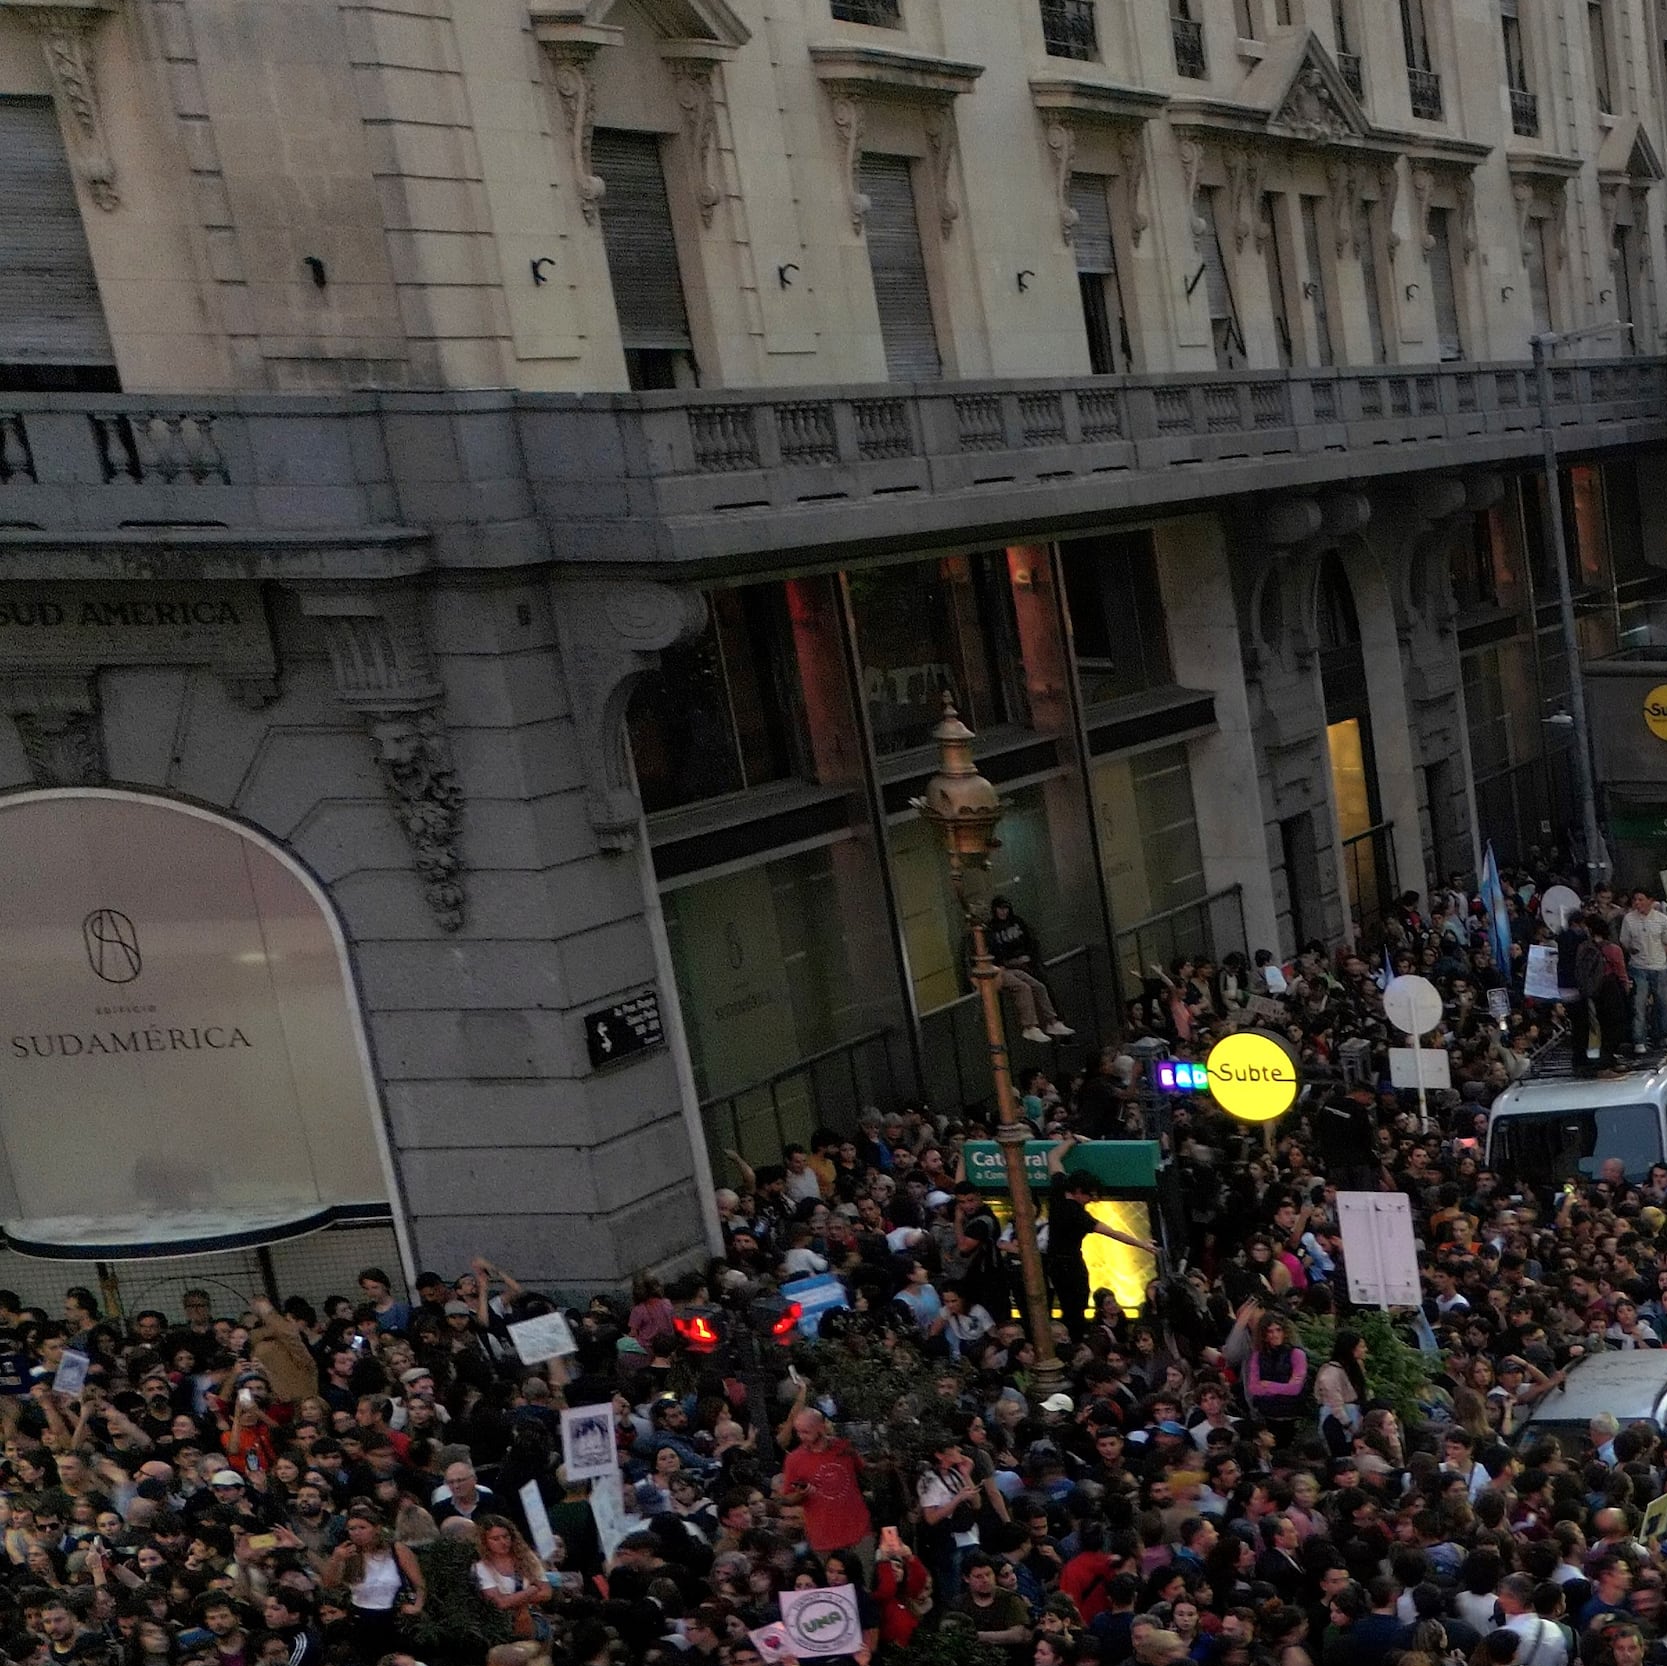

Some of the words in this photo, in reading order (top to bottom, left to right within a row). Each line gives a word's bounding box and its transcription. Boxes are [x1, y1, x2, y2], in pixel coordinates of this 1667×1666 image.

[79, 601, 241, 627] AMERICA
[11, 1024, 253, 1058] SUDAMÉRICA
[1219, 1063, 1297, 1082] Subte
[971, 1151, 1048, 1167] Catral
[802, 1610, 842, 1633] UNA
